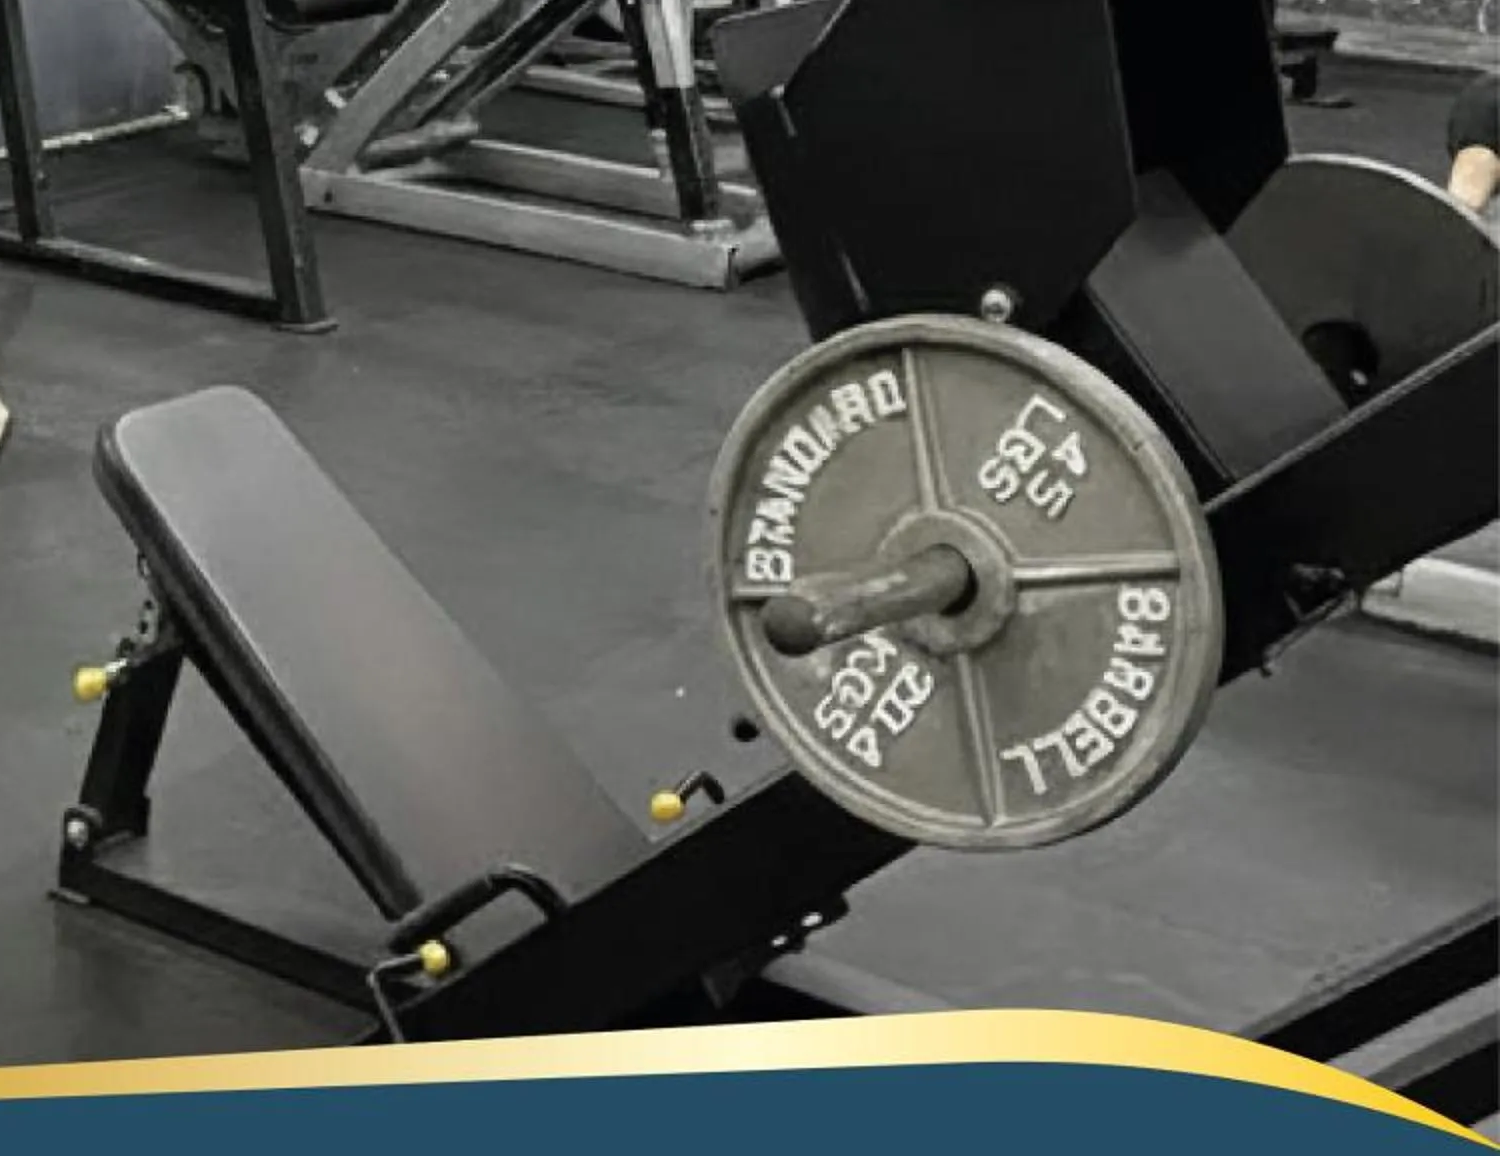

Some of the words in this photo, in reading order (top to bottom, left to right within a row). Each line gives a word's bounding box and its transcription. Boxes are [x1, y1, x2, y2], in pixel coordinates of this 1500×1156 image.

[977, 392, 1067, 503] LBS
[813, 627, 898, 741] KGS
[1000, 583, 1172, 795] BARBELL
